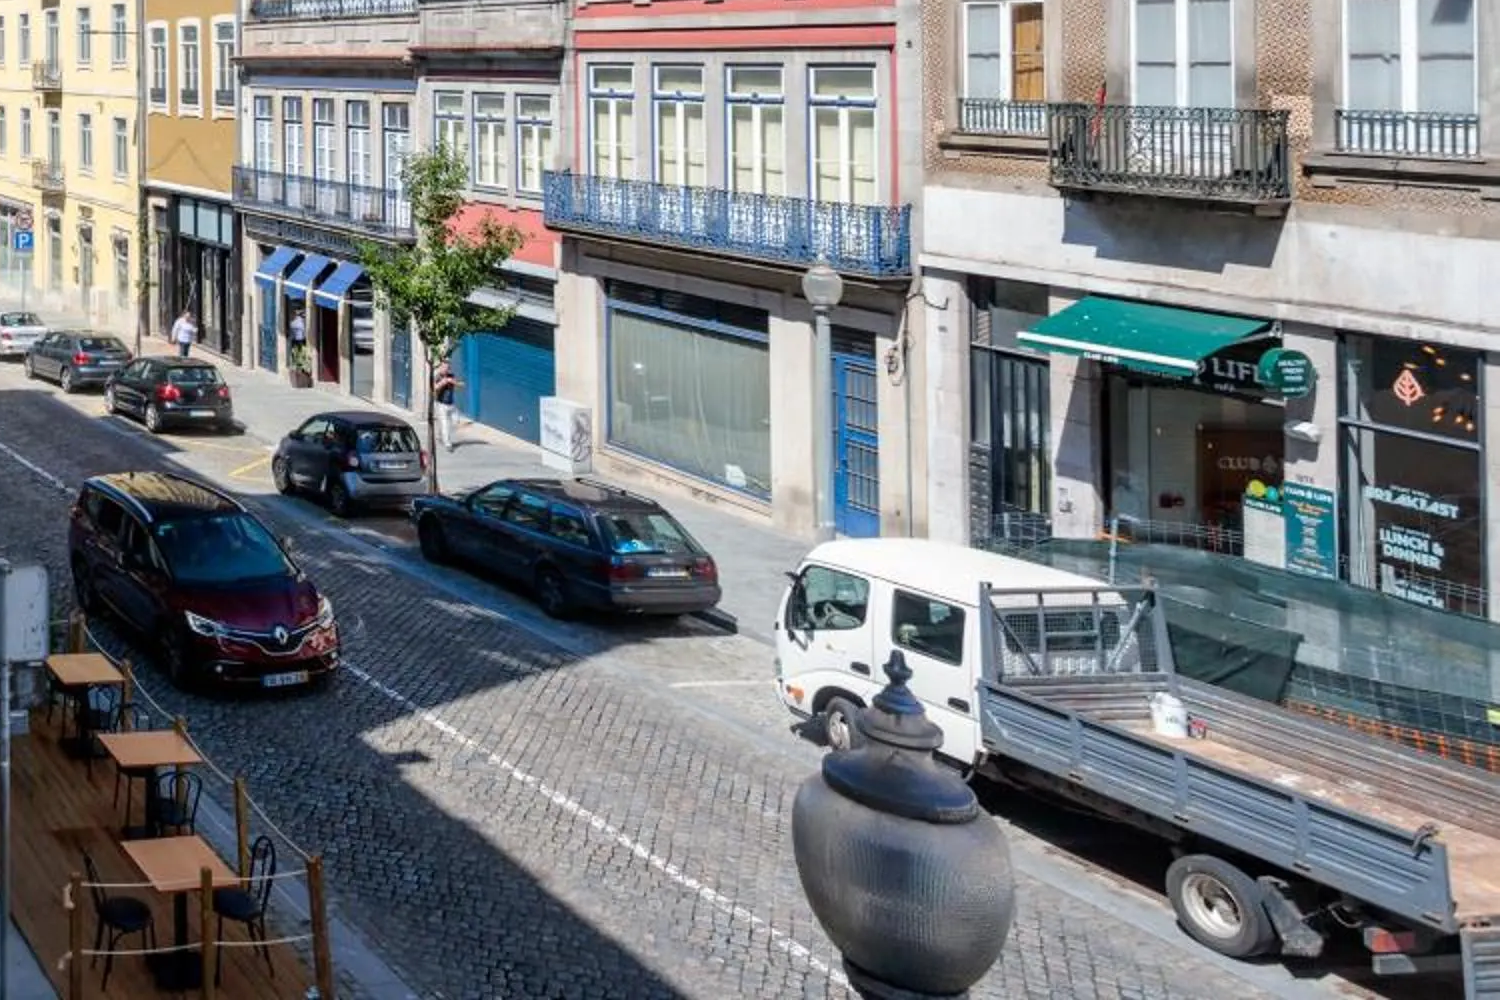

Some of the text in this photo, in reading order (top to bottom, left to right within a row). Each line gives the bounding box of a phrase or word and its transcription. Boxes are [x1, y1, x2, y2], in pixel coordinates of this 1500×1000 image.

[1364, 486, 1458, 518] BREAKFAST
[1380, 527, 1428, 553] LUNCH
[1432, 542, 1444, 557] &
[1383, 544, 1441, 571] DINNER
